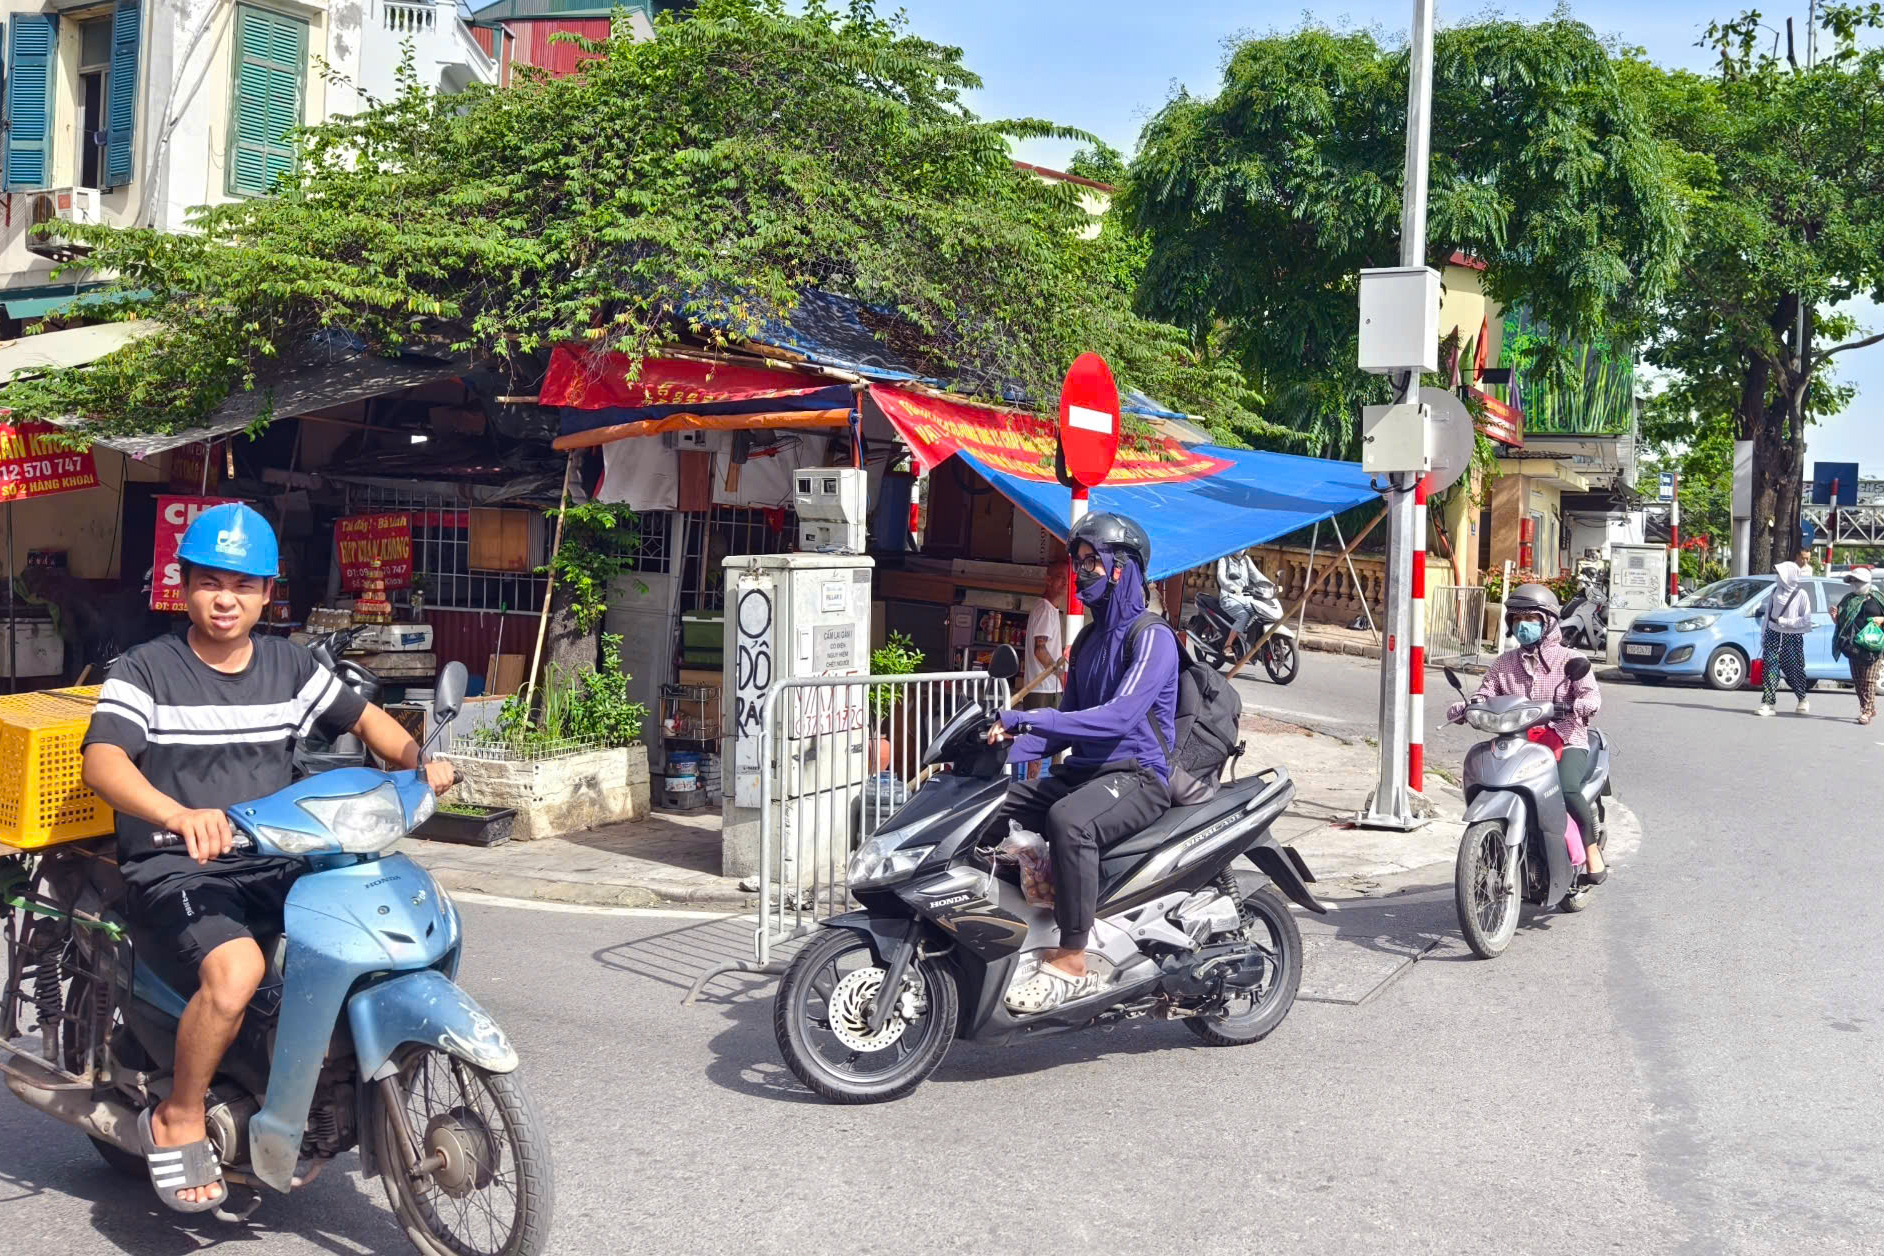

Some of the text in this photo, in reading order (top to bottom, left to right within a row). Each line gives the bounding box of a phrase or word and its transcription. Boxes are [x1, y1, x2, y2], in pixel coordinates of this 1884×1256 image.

[23, 460, 51, 478] 570
[54, 456, 81, 473] 747
[20, 483, 26, 494] 2
[29, 479, 60, 492] HÀNG
[365, 876, 401, 888] HONDA
[929, 894, 970, 908] HONDA
